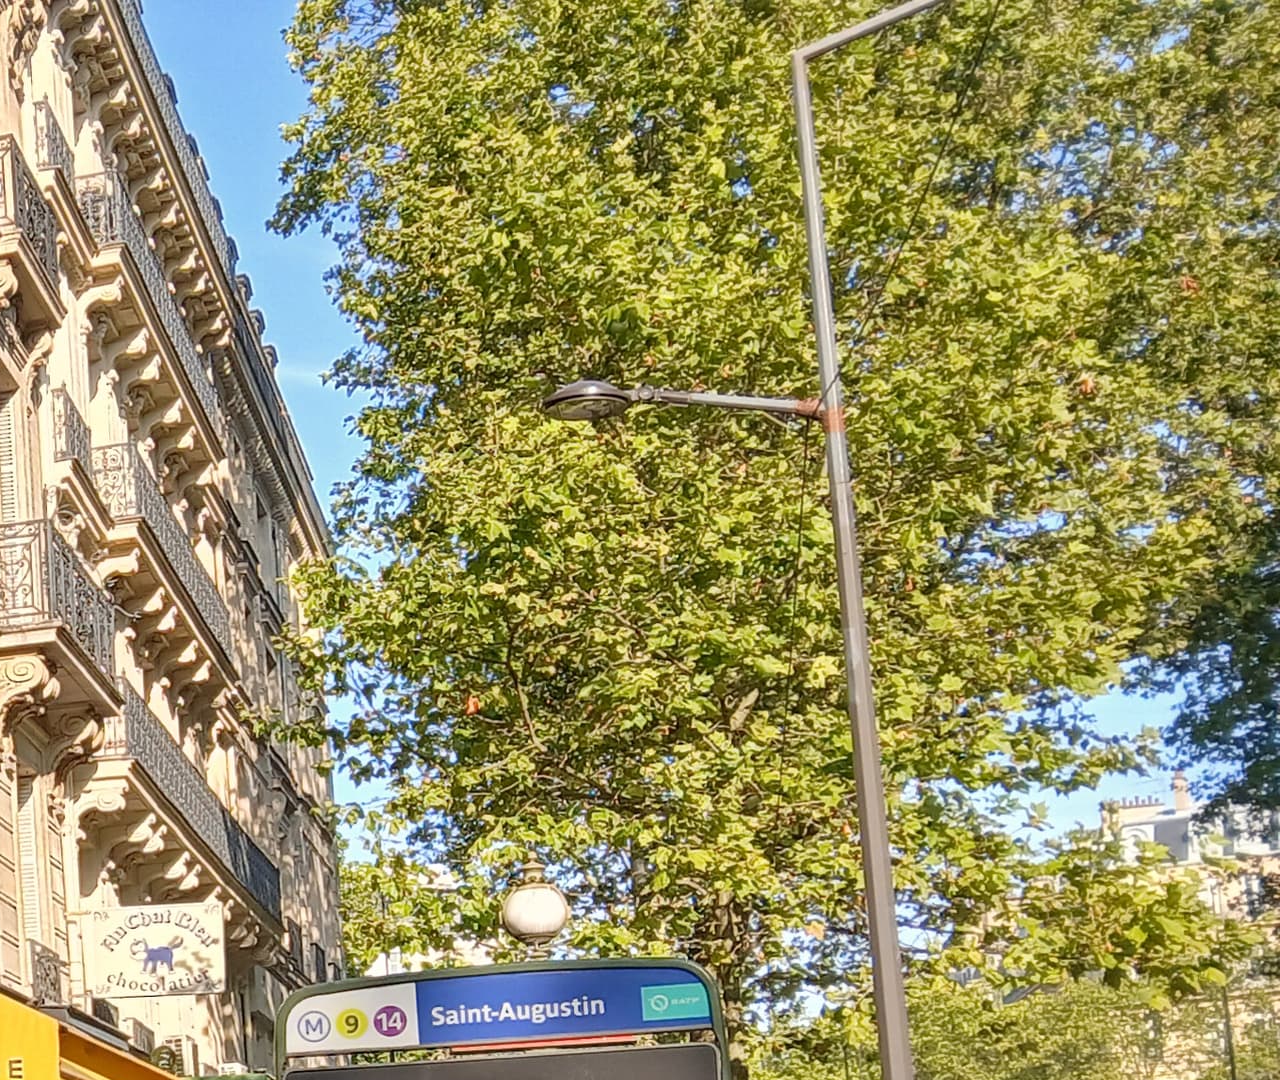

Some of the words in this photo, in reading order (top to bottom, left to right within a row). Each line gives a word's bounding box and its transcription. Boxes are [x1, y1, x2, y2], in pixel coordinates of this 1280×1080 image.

[125, 909, 172, 930] Chat
[174, 911, 215, 948] Bleu
[305, 1018, 324, 1034] M
[345, 1015, 359, 1034] 9
[377, 1013, 402, 1031] 14
[431, 996, 605, 1027] Saint-Augustin
